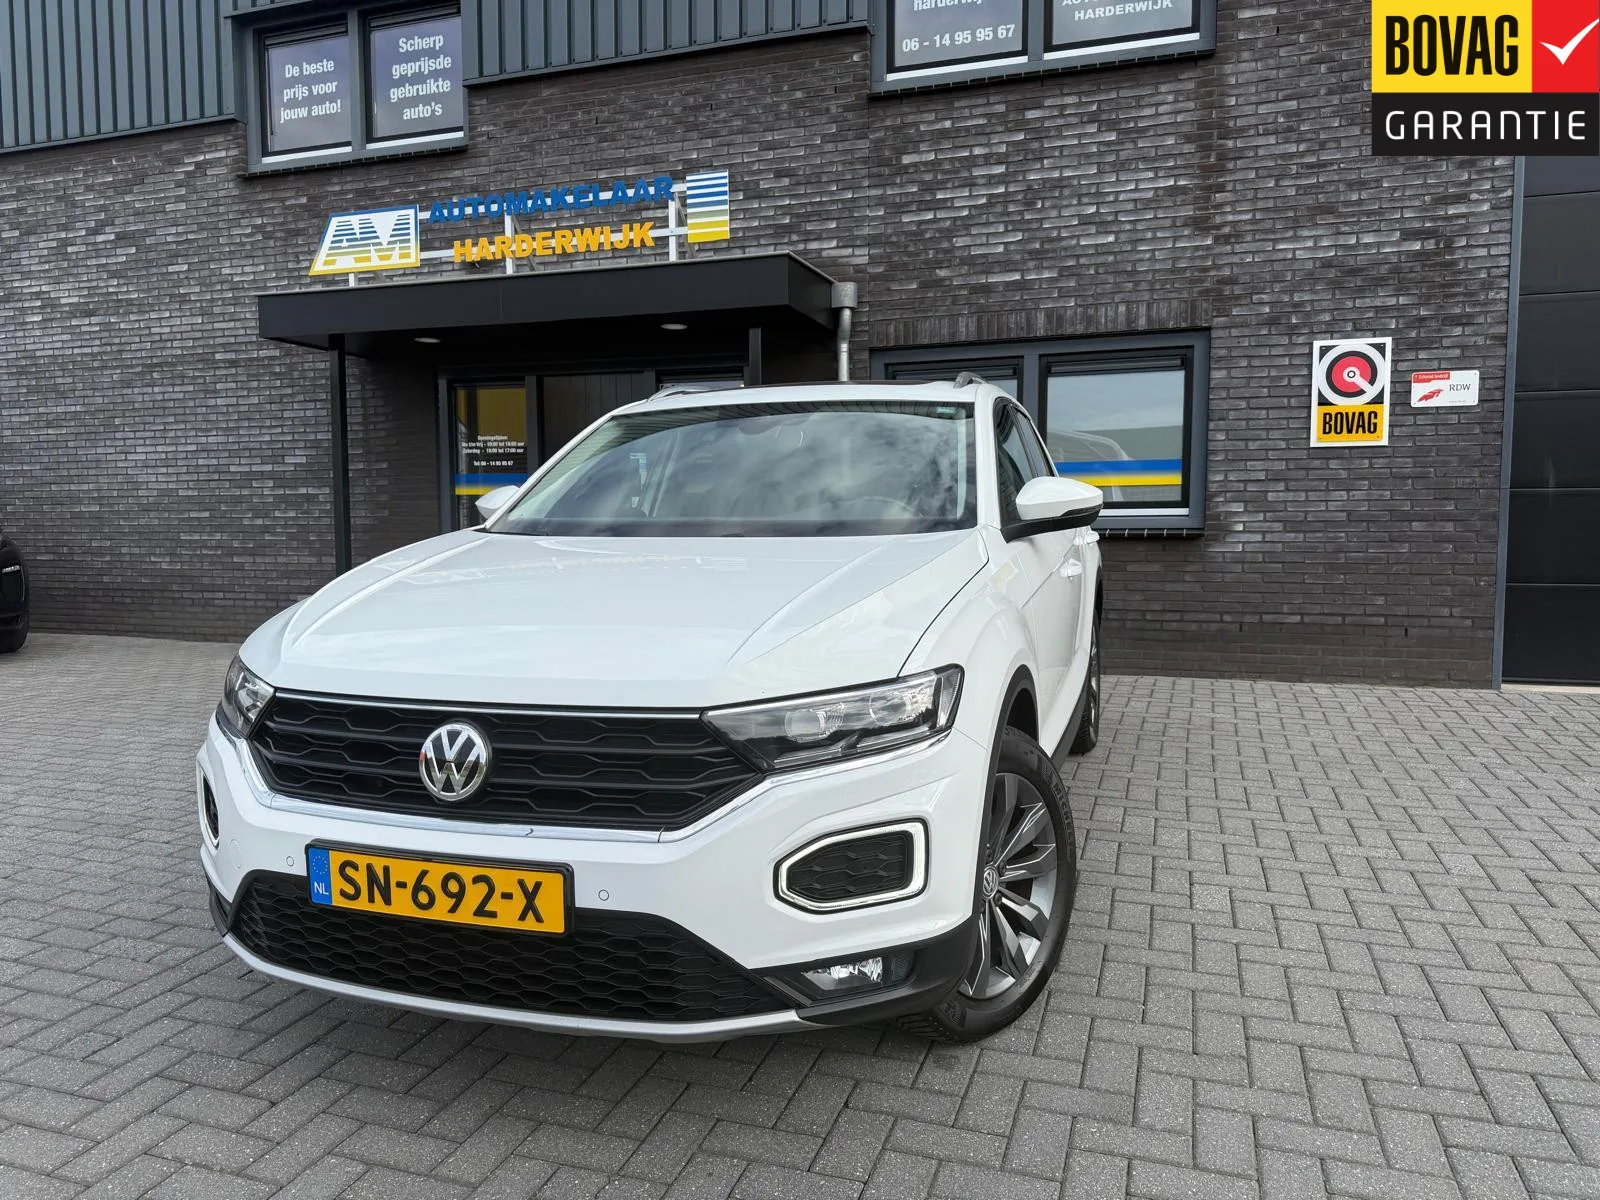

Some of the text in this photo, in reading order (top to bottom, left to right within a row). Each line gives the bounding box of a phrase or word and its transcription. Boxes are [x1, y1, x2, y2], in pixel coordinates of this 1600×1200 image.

[1074, 0, 1173, 21] HARDERWIJK
[398, 35, 444, 53] Scherp
[902, 38, 919, 52] 06
[933, 33, 951, 47] 14
[954, 30, 972, 45] 95
[975, 27, 993, 42] 95
[997, 24, 1015, 39] 67
[285, 58, 335, 78] De beste
[392, 54, 452, 79] geprijsde
[283, 81, 338, 103] prijs voor
[389, 77, 451, 103] gebruikte
[280, 98, 341, 124] jouw auto!
[428, 175, 674, 225] AUTOMAKELAAR
[321, 213, 413, 267] AM
[453, 221, 656, 264] HARDERWIJK
[1449, 383, 1471, 392] RDW
[1322, 410, 1378, 435] BOVAG
[314, 881, 329, 895] NL
[338, 859, 544, 924] SN-692-X
